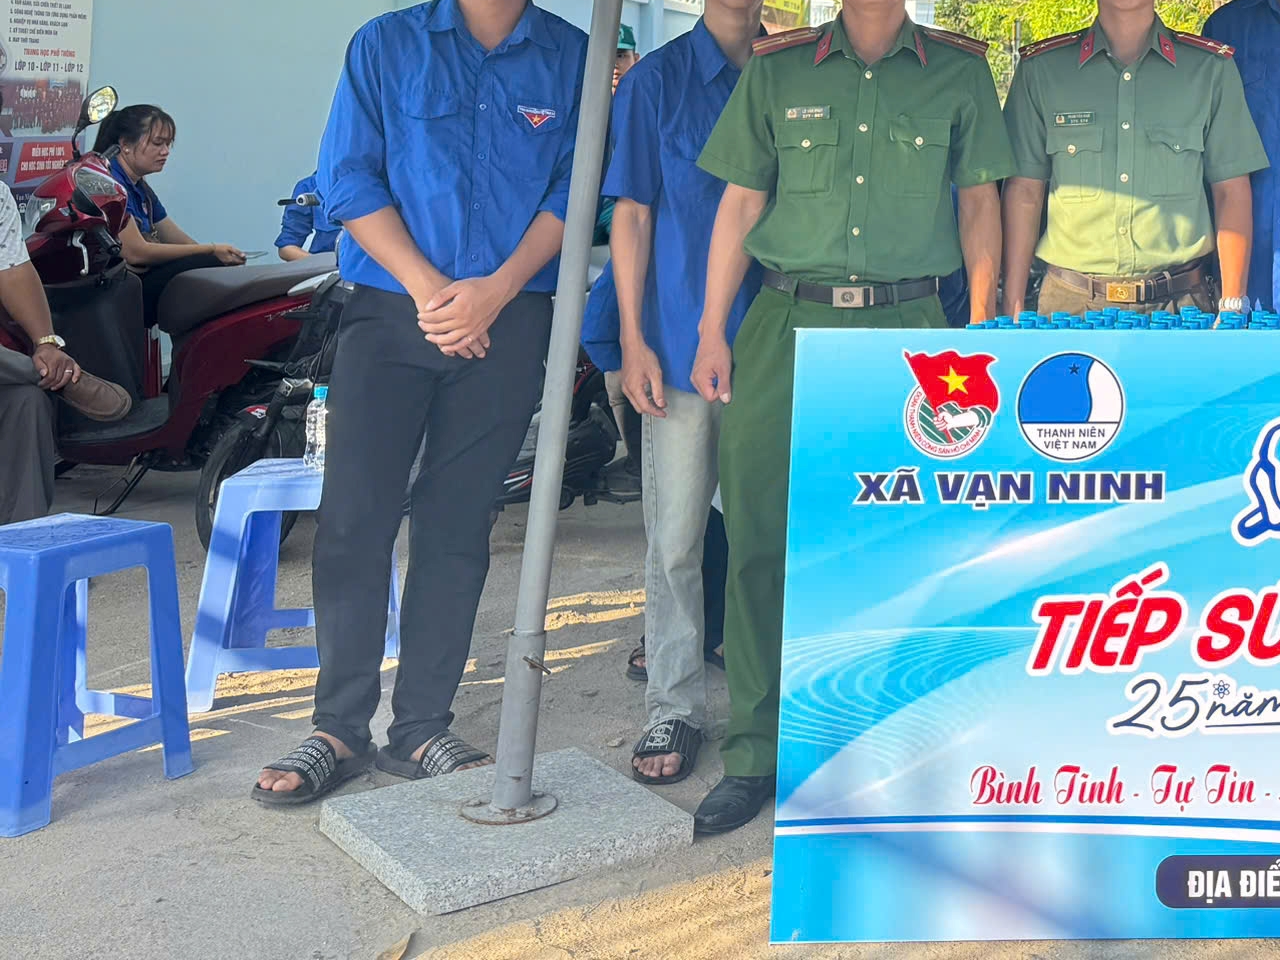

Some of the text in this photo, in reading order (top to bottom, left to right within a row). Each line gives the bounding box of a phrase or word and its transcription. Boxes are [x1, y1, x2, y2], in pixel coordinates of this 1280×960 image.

[28, 62, 34, 71] 10
[77, 64, 83, 72] 12
[1037, 427, 1106, 438] THANH NIÊN
[1043, 439, 1097, 451] VIỆT NAM
[856, 467, 1164, 508] XÃ VẠN NINH
[1032, 567, 1183, 670] TIẾP
[1112, 678, 1209, 732] 25
[970, 764, 1043, 805] Bình
[1054, 764, 1126, 805] Tĩnh
[1151, 764, 1195, 812] Tự
[1205, 764, 1257, 805] Tin
[1187, 870, 1232, 904] ĐỊA
